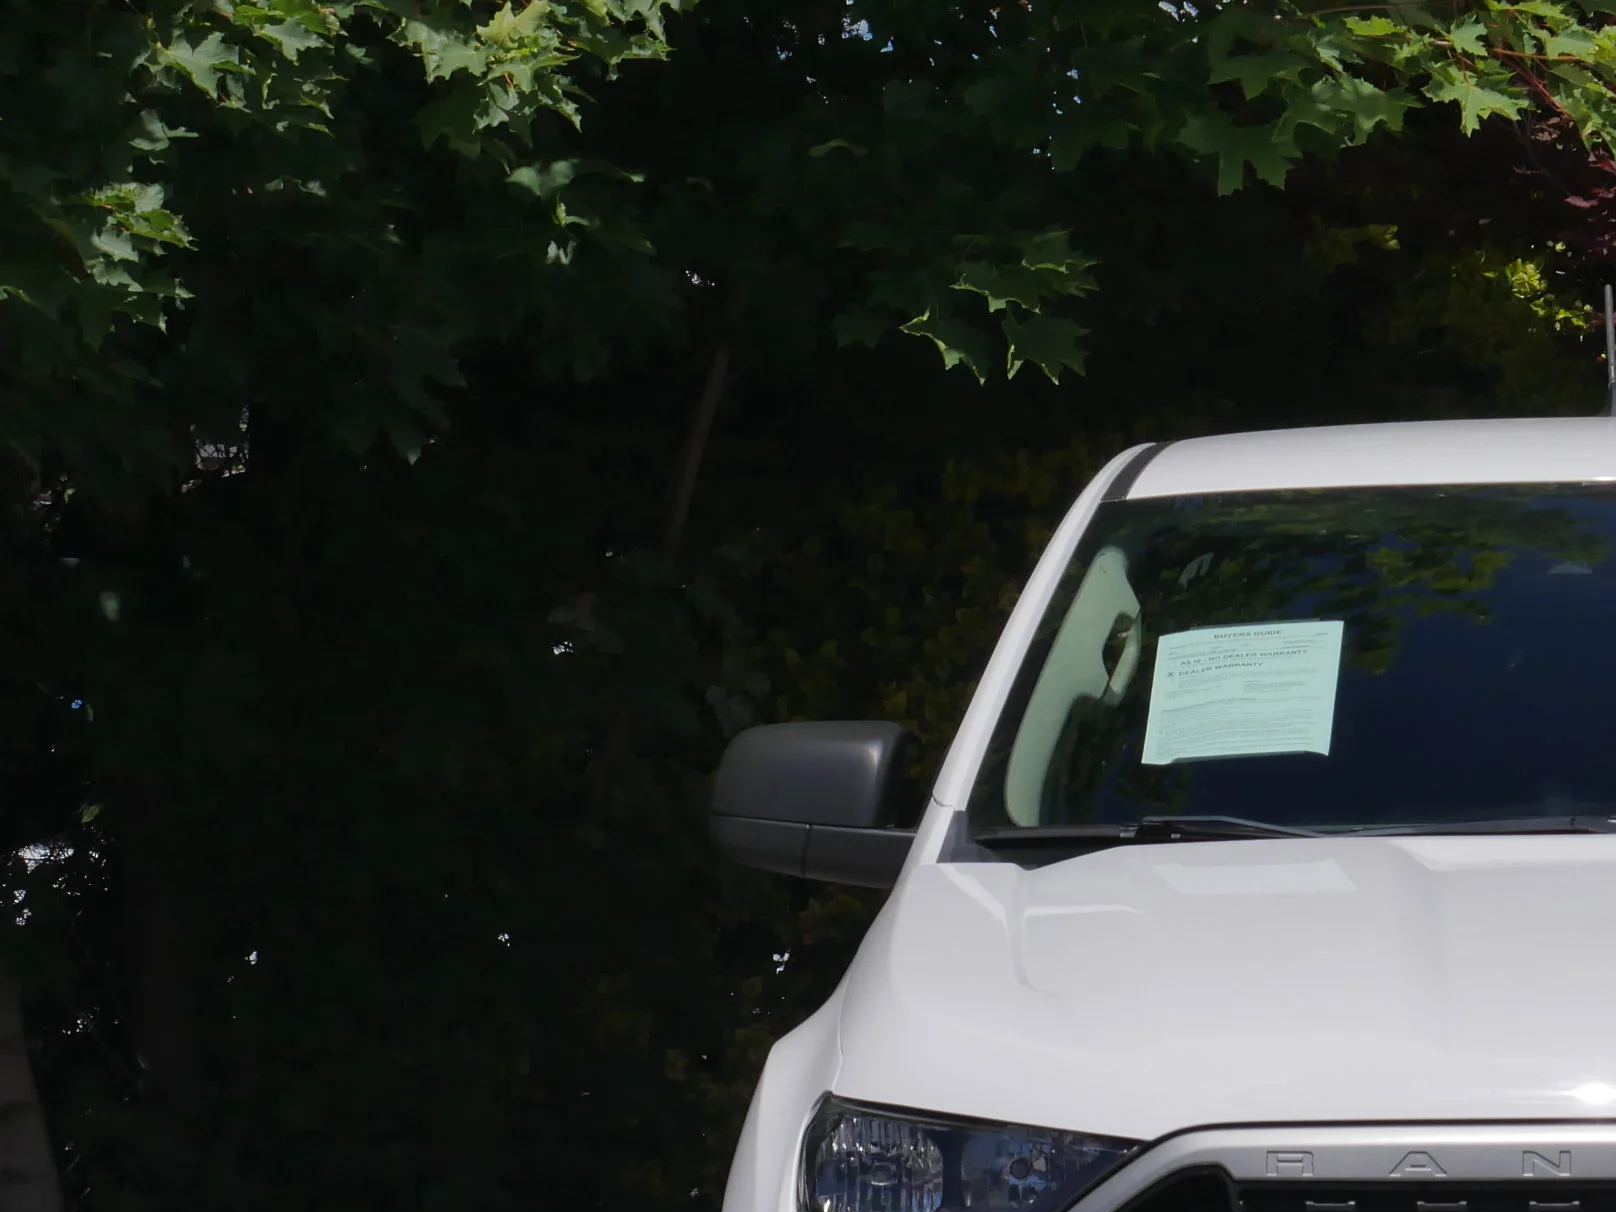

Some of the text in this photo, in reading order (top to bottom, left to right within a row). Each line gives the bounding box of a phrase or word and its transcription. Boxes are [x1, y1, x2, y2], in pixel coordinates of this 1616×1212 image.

[1213, 629, 1283, 640] BUYERS GUIDE
[1222, 651, 1257, 661] DEALER
[1259, 649, 1308, 657] WARRANTY
[1178, 667, 1213, 677] DEALER
[1214, 661, 1264, 671] WARRANTY
